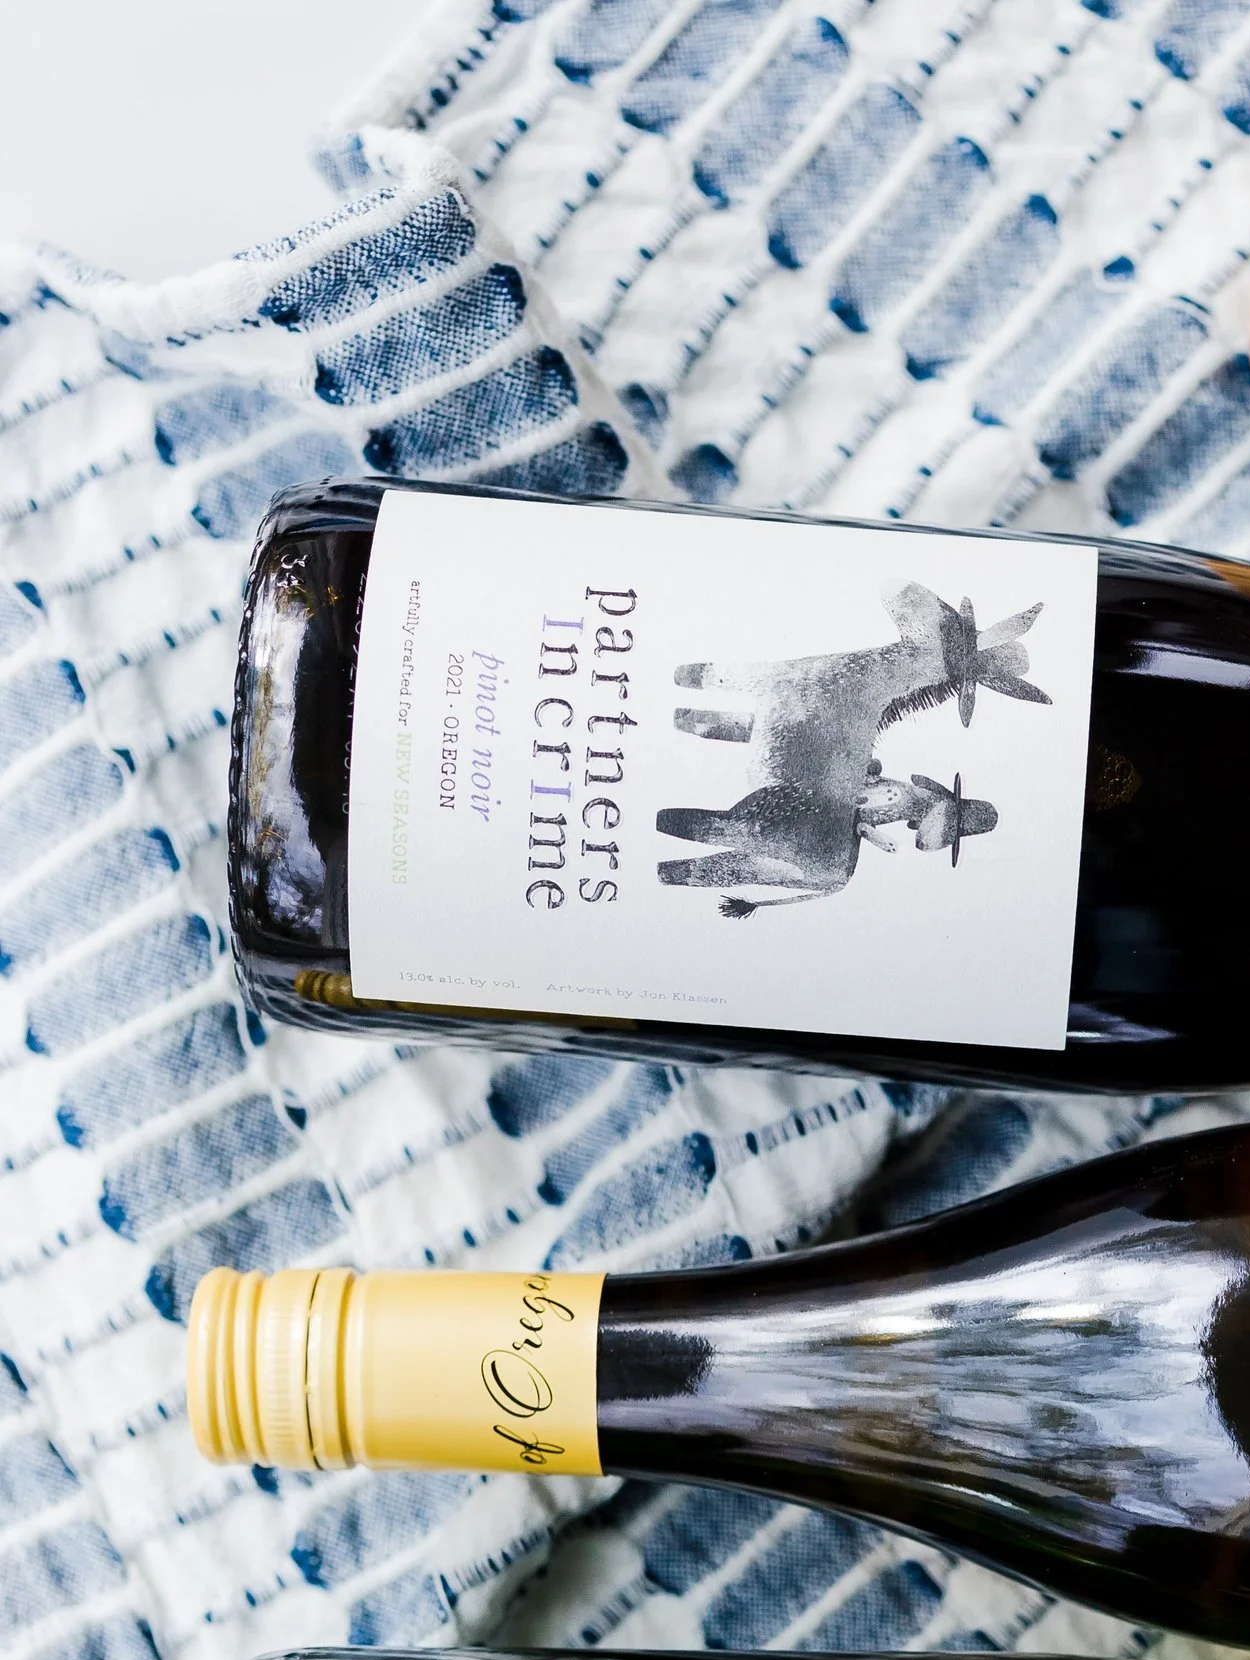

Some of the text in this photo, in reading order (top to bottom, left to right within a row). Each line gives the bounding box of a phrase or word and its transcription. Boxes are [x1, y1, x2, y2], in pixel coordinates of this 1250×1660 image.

[392, 580, 421, 886] artfully crafted for NEW SEASONS
[439, 653, 464, 810] 2021 OREGON
[470, 649, 509, 823] pinot noir
[578, 586, 638, 903] partners
[439, 975, 465, 985] alc.
[469, 977, 486, 988] by
[492, 979, 521, 990] vol.
[546, 982, 612, 997] Artwork
[616, 987, 633, 1000] by
[639, 990, 667, 1002] Jon
[493, 1424, 565, 1465] of
